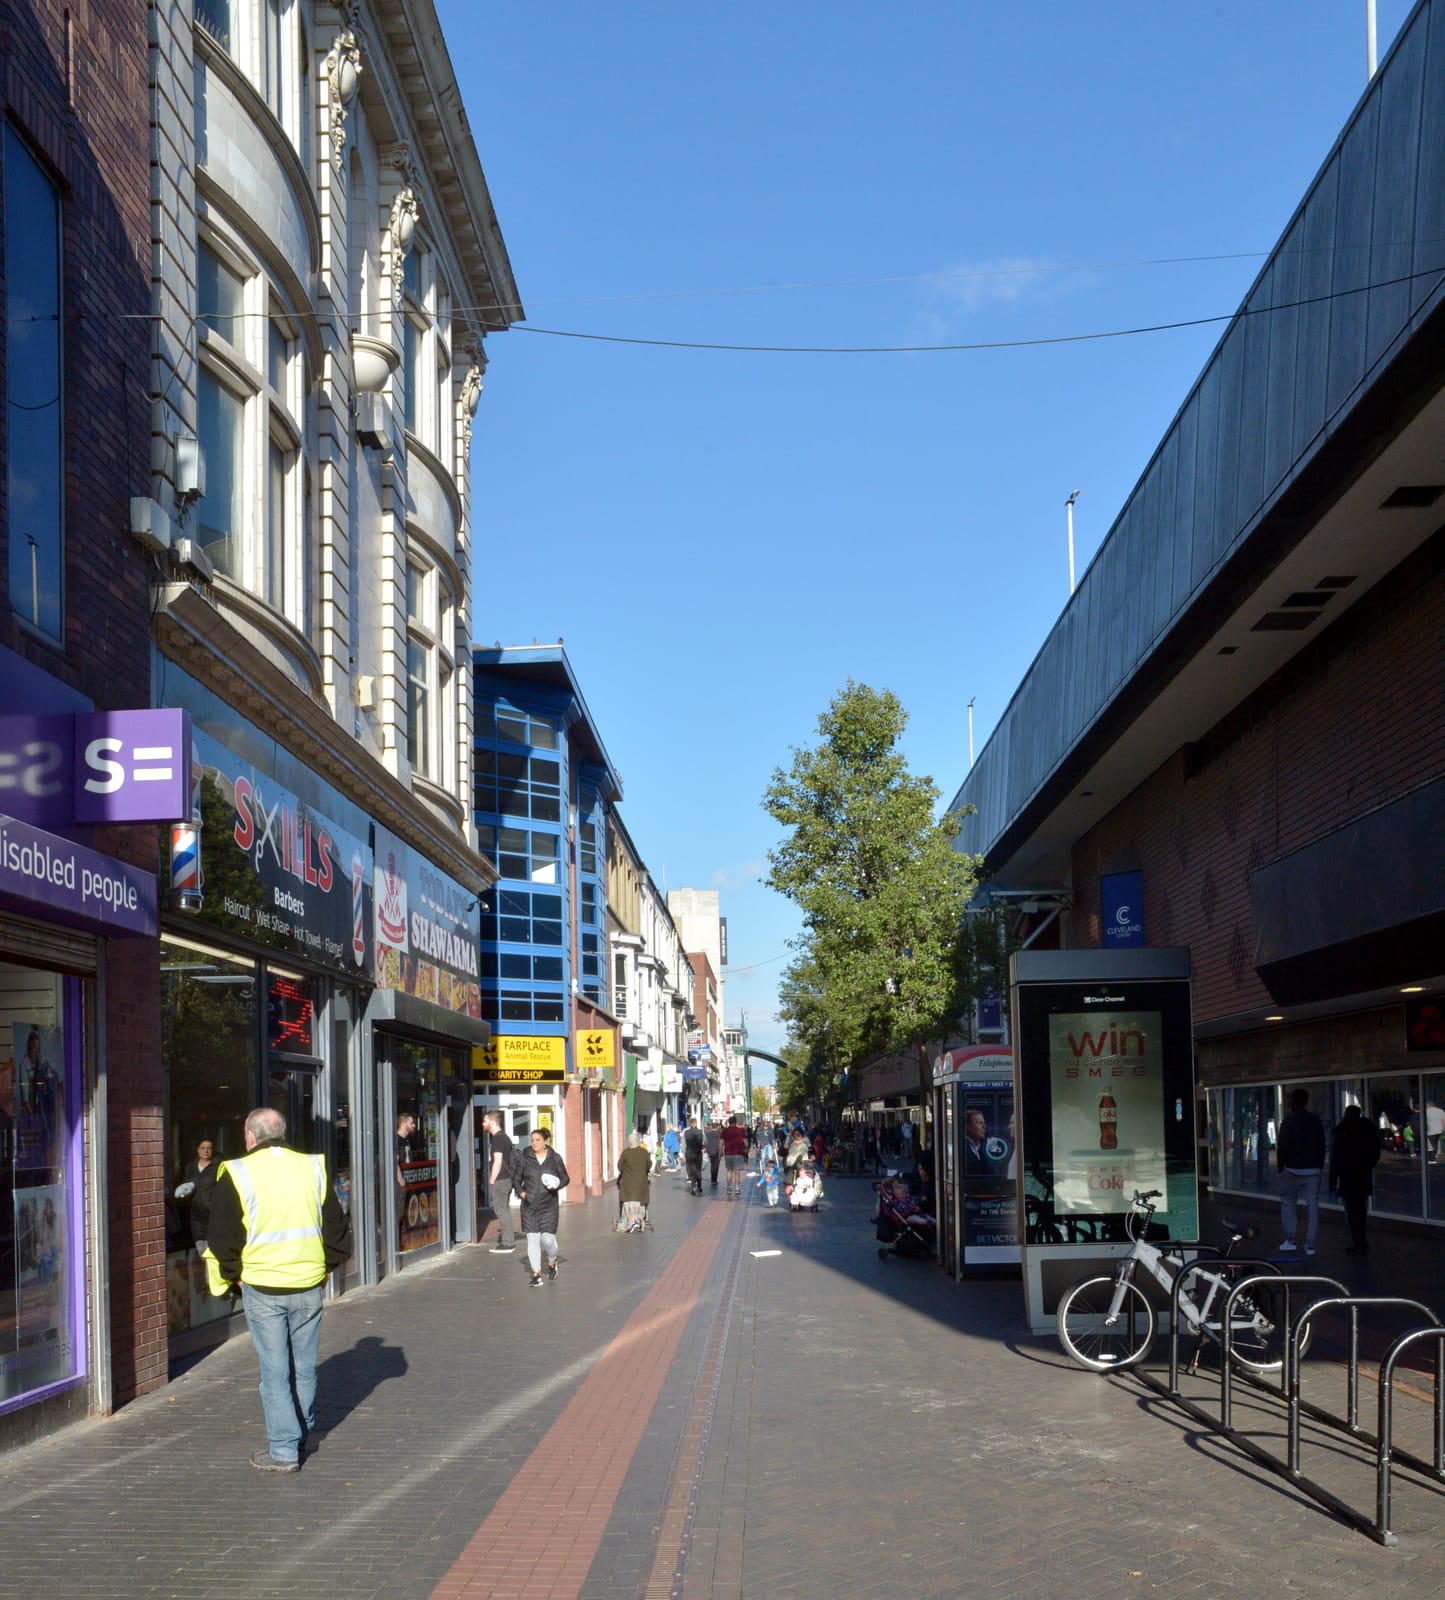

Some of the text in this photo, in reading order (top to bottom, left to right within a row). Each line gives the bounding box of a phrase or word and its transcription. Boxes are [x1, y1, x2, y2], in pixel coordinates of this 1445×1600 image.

[0, 831, 138, 912] isabled people
[274, 887, 305, 917] Barbers
[224, 896, 250, 921] Haircut
[256, 909, 271, 929] Wet
[272, 916, 291, 936] Shave
[294, 925, 304, 942] Hot
[305, 930, 322, 949] Towel
[1106, 924, 1141, 936] CLEVELAND
[411, 912, 478, 977] SHAWARMA
[504, 1040, 552, 1051] FARPLACE
[1067, 1022, 1145, 1057] win
[505, 1052, 552, 1061] Animal Rescue
[489, 1071, 544, 1080] CHARITY SHOP
[1066, 1066, 1146, 1079] SMEG
[404, 1169, 418, 1183] FRESH
[418, 1167, 431, 1181] EVERY
